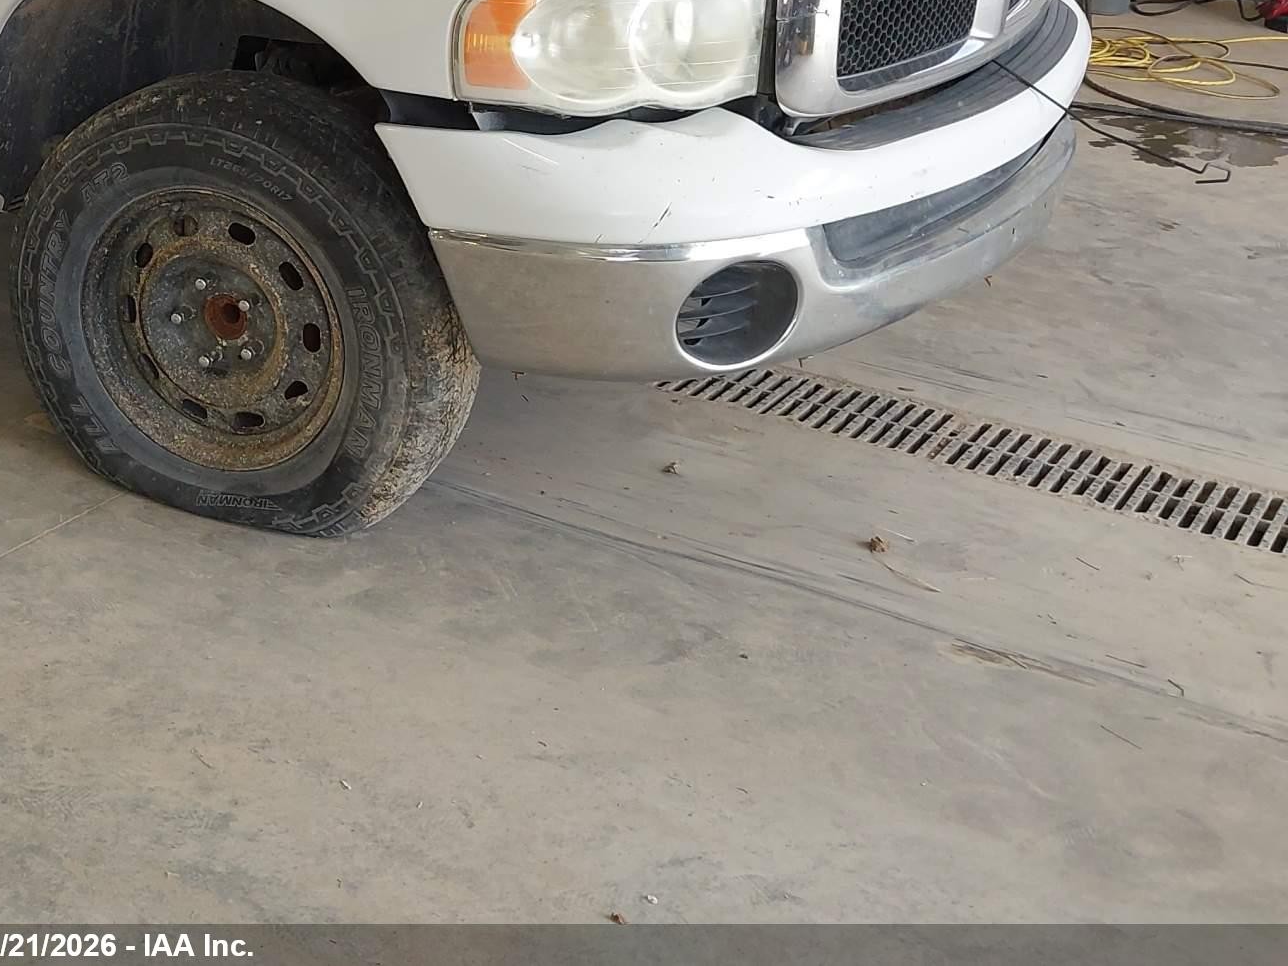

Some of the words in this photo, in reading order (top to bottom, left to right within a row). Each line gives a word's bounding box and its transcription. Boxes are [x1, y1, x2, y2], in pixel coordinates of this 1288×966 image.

[38, 209, 72, 375] COUNTRY
[347, 287, 383, 458] IRONMAN
[196, 491, 268, 510] IRONMAN
